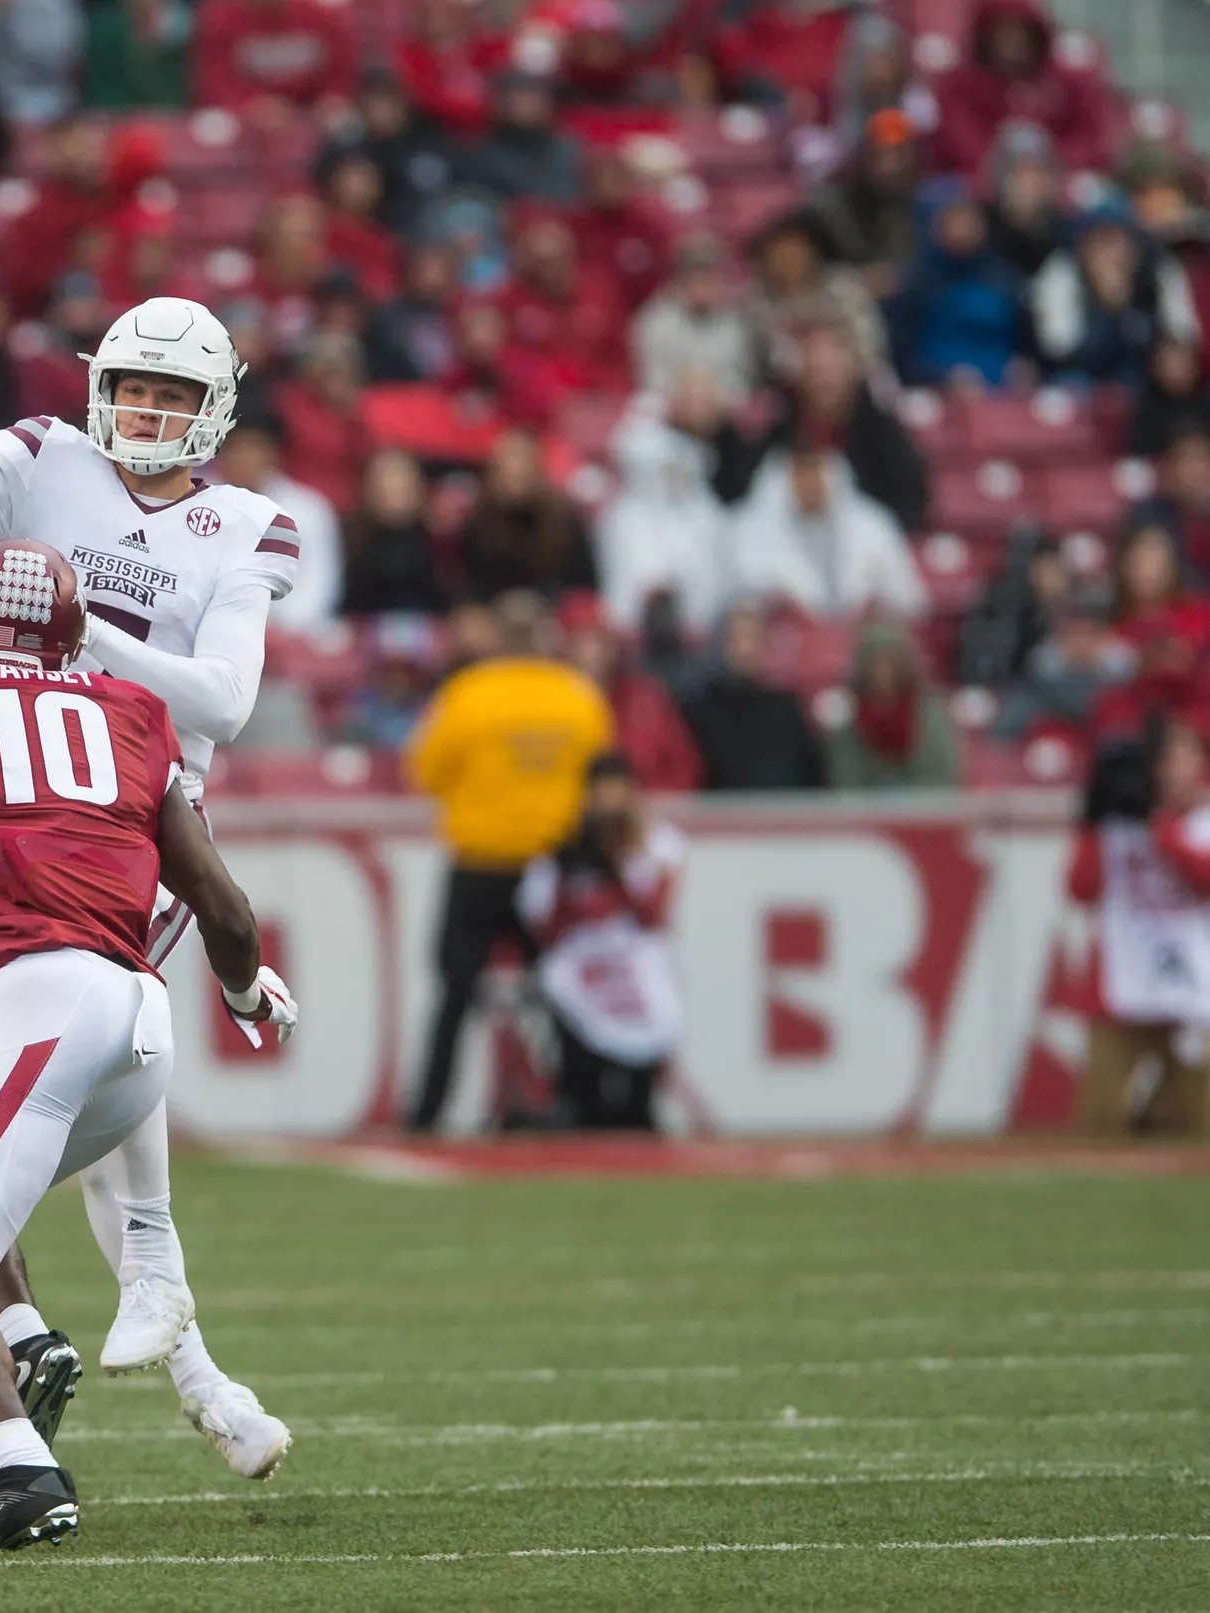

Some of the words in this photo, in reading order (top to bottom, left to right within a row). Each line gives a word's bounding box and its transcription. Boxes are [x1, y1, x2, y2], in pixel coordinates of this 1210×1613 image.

[186, 507, 221, 537] SEC
[118, 537, 150, 554] adidas
[69, 548, 178, 591] MISSISSIPPI
[96, 576, 146, 601] STATE
